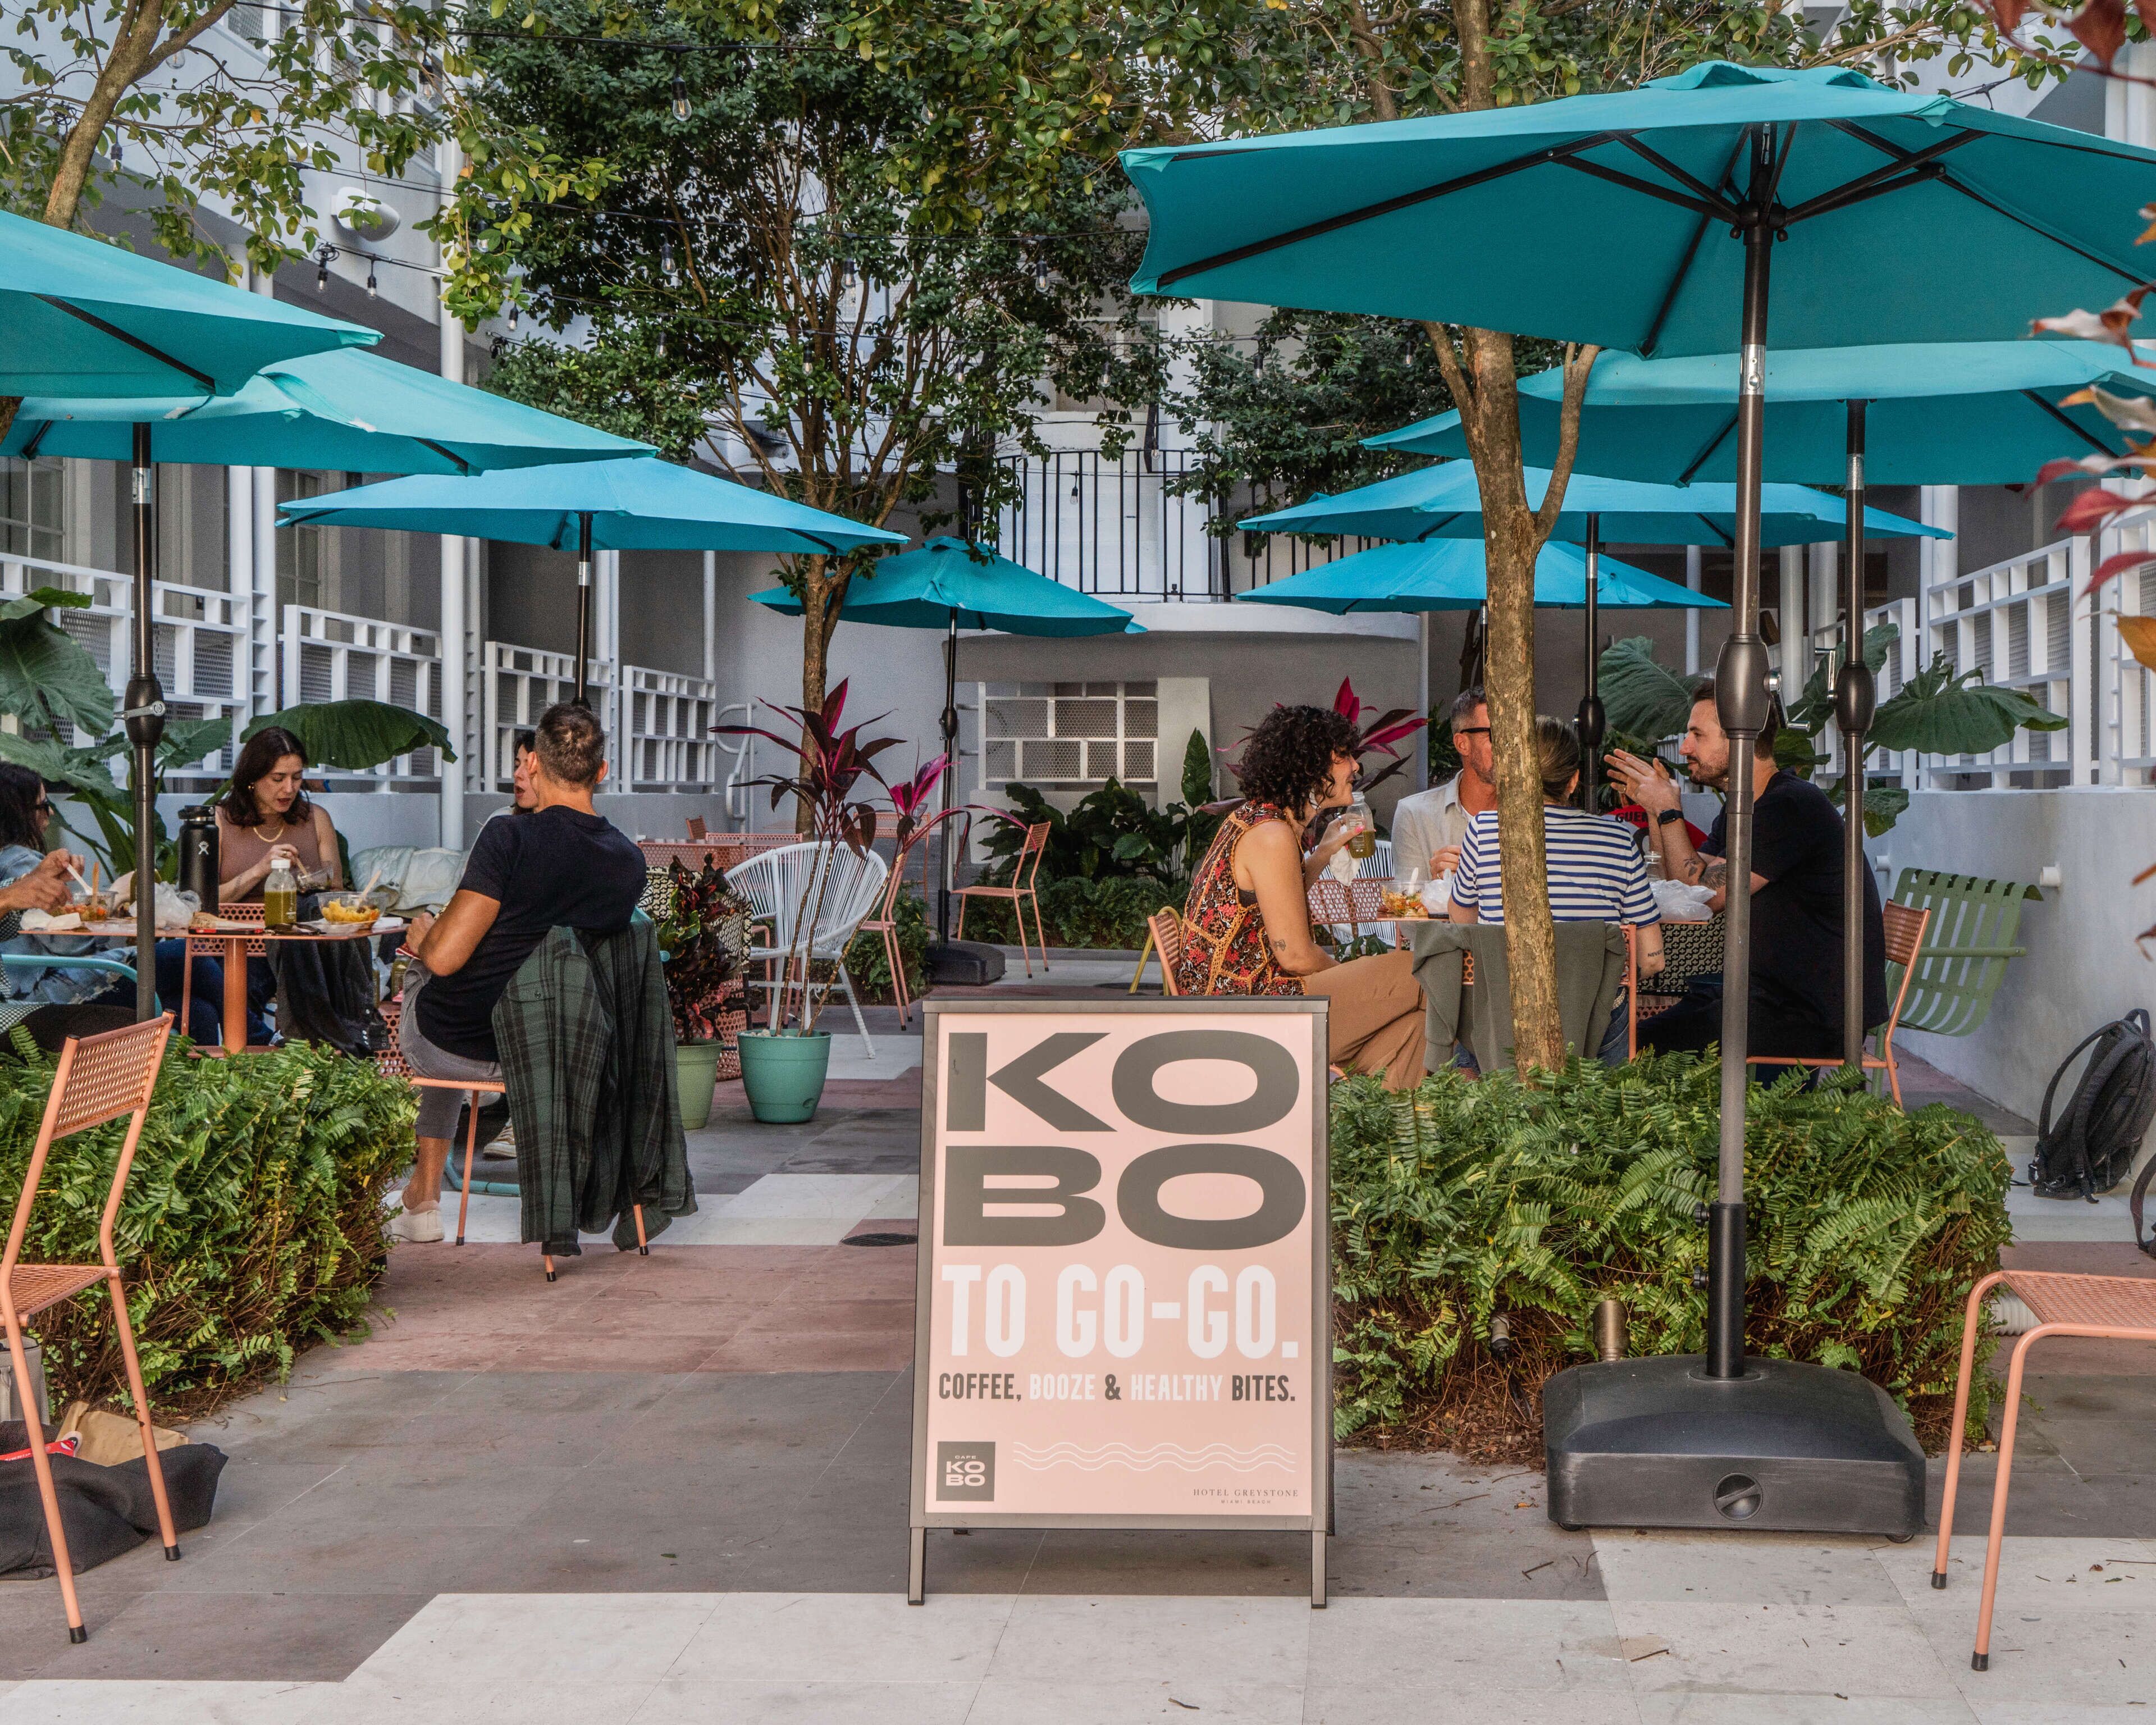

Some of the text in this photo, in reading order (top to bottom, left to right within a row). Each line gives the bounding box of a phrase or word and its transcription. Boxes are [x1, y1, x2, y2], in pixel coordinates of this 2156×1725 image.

[946, 1029, 1300, 1135] KO
[943, 1143, 1306, 1251] BO
[942, 1263, 1298, 1359] TO GO-GO.
[939, 1373, 1295, 1402] COFFEE, BOOZE & HEALTHY BITES.
[945, 1474, 985, 1486] BO
[946, 1461, 985, 1473] KO
[1234, 1489, 1299, 1497] GREYSTONE
